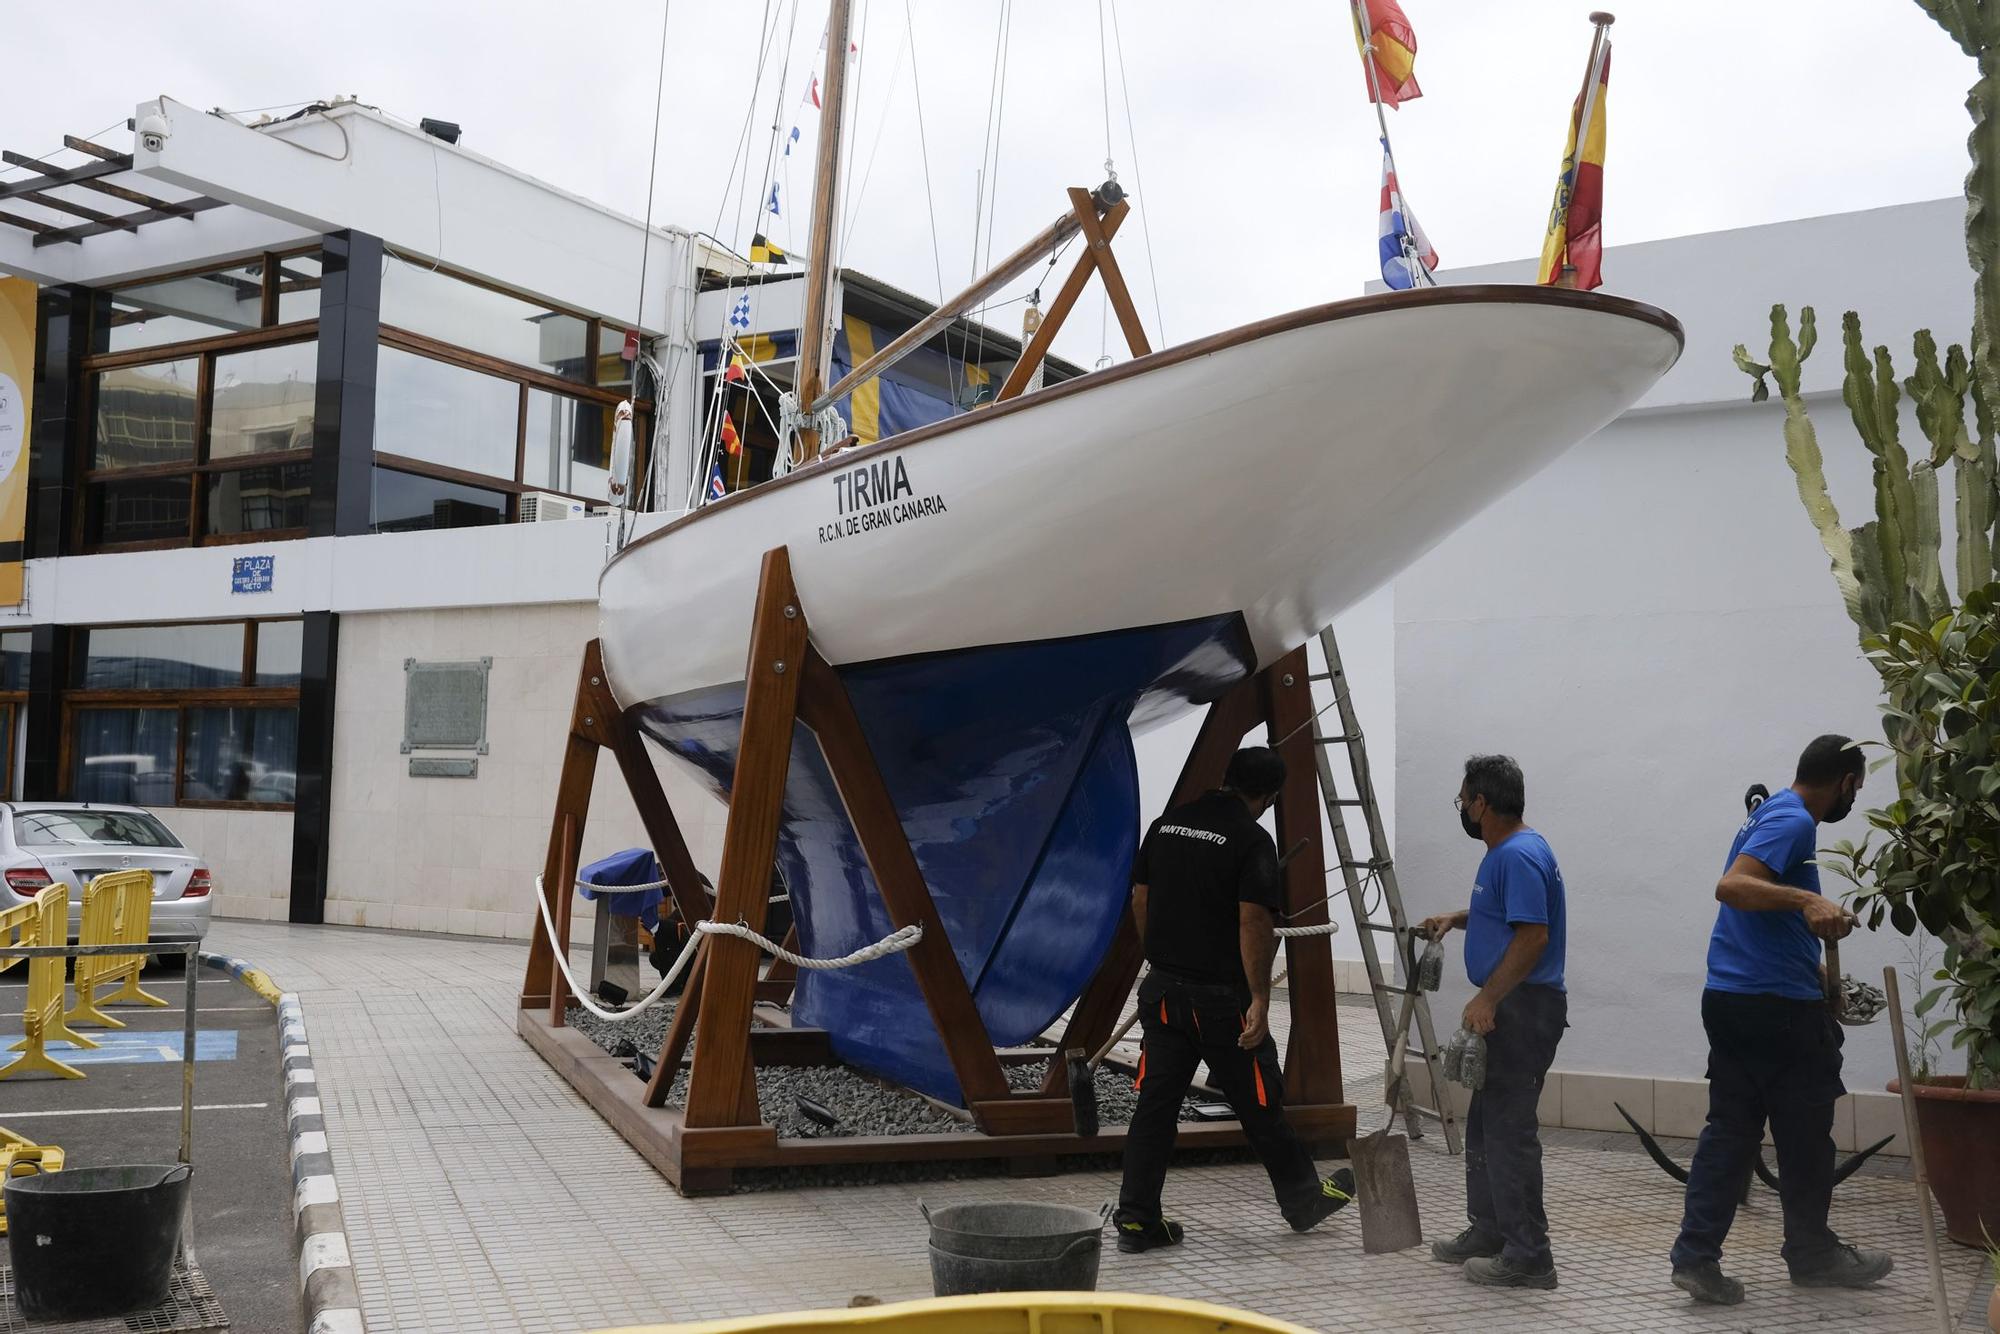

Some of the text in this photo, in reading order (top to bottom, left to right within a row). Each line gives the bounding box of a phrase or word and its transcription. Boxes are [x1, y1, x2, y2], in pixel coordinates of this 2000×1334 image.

[833, 455, 913, 515] TIRMA
[819, 494, 947, 544] R.C.N. DE GRAN CANARIA
[244, 560, 271, 571] PLAZA
[1158, 825, 1227, 845] MANTENIMIENTO
